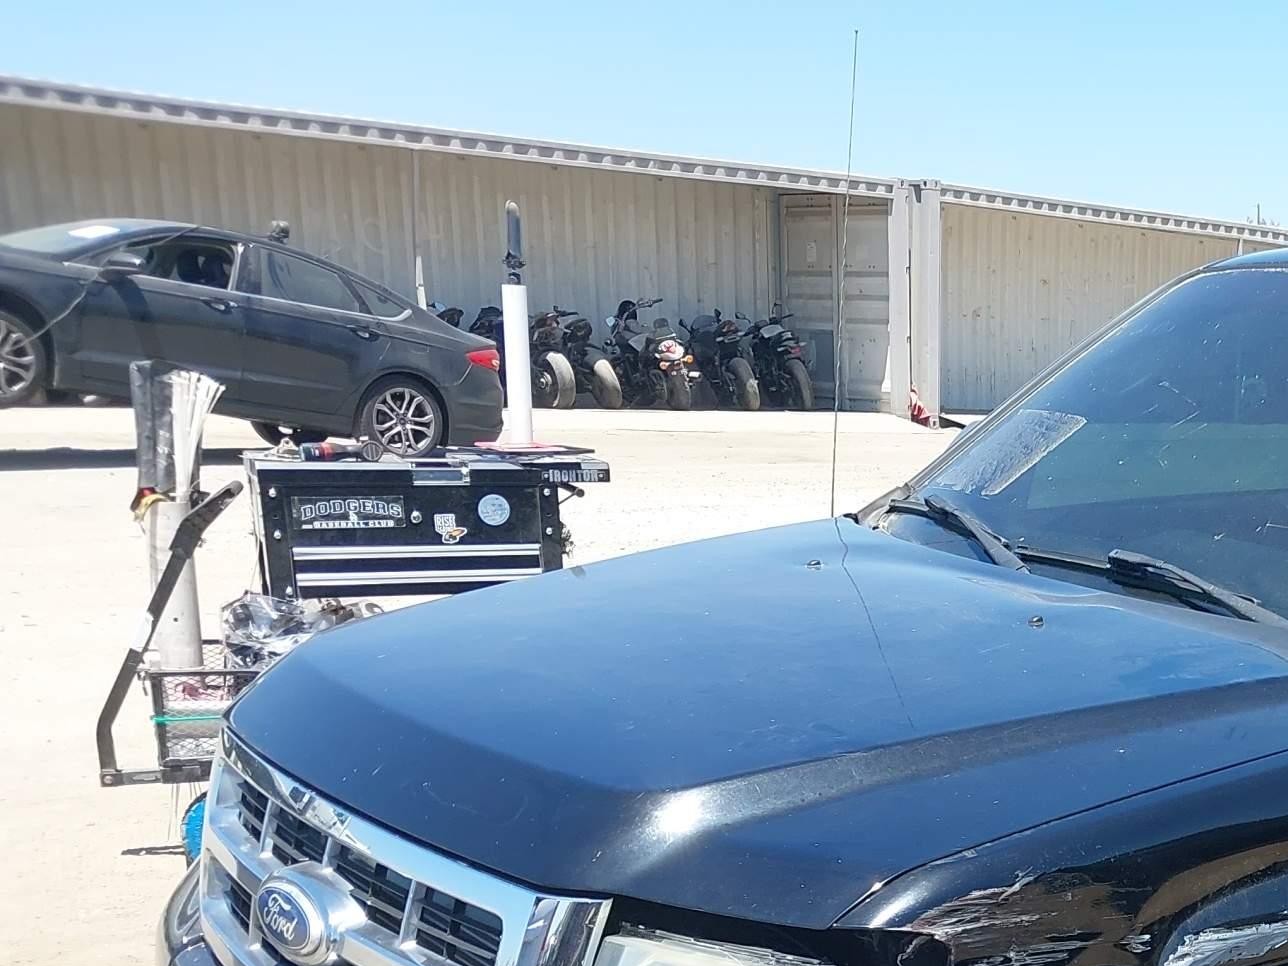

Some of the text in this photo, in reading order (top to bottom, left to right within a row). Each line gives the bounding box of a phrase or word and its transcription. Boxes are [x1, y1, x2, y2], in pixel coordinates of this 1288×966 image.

[548, 469, 599, 482] IRONTON
[301, 500, 402, 520] DODGERS
[368, 519, 395, 528] CLUB
[263, 894, 298, 941] Ford
